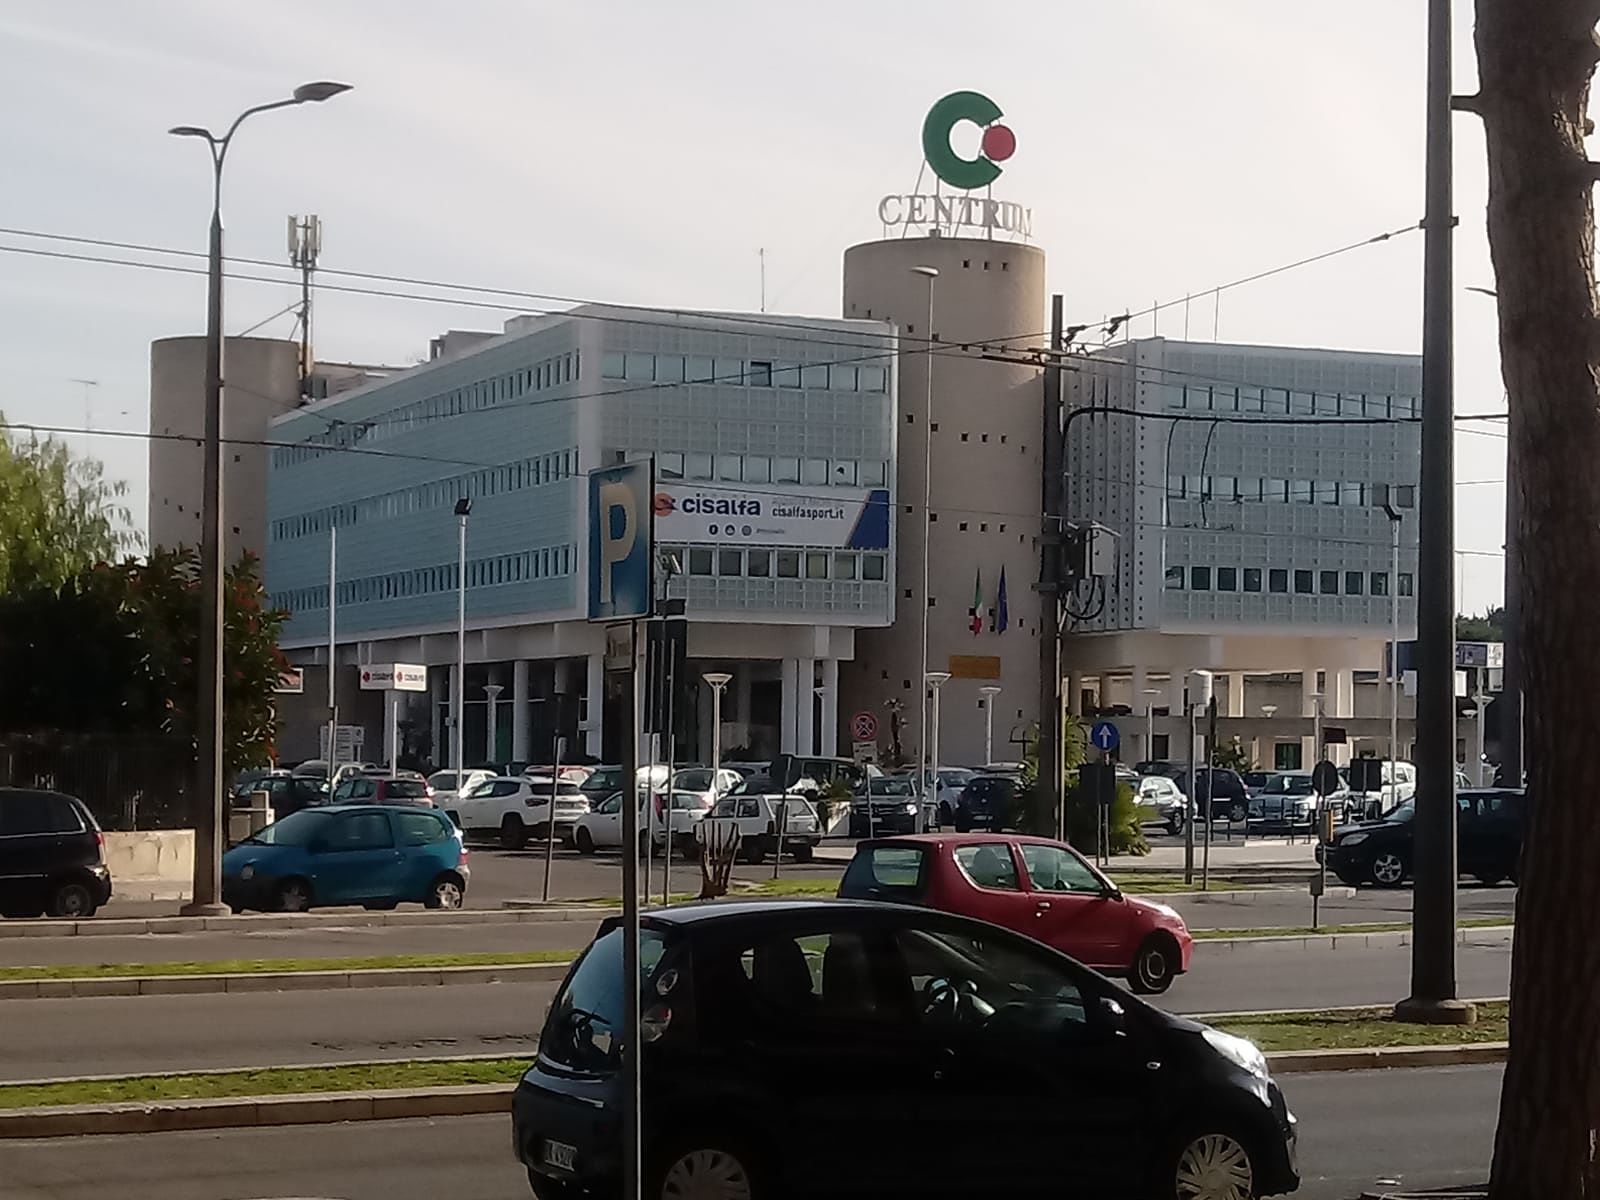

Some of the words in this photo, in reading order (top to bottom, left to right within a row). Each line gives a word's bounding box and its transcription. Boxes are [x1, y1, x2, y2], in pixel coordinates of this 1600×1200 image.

[600, 483, 637, 603] P
[683, 492, 761, 516] cisalfa
[772, 507, 845, 522] cisalfasport.it
